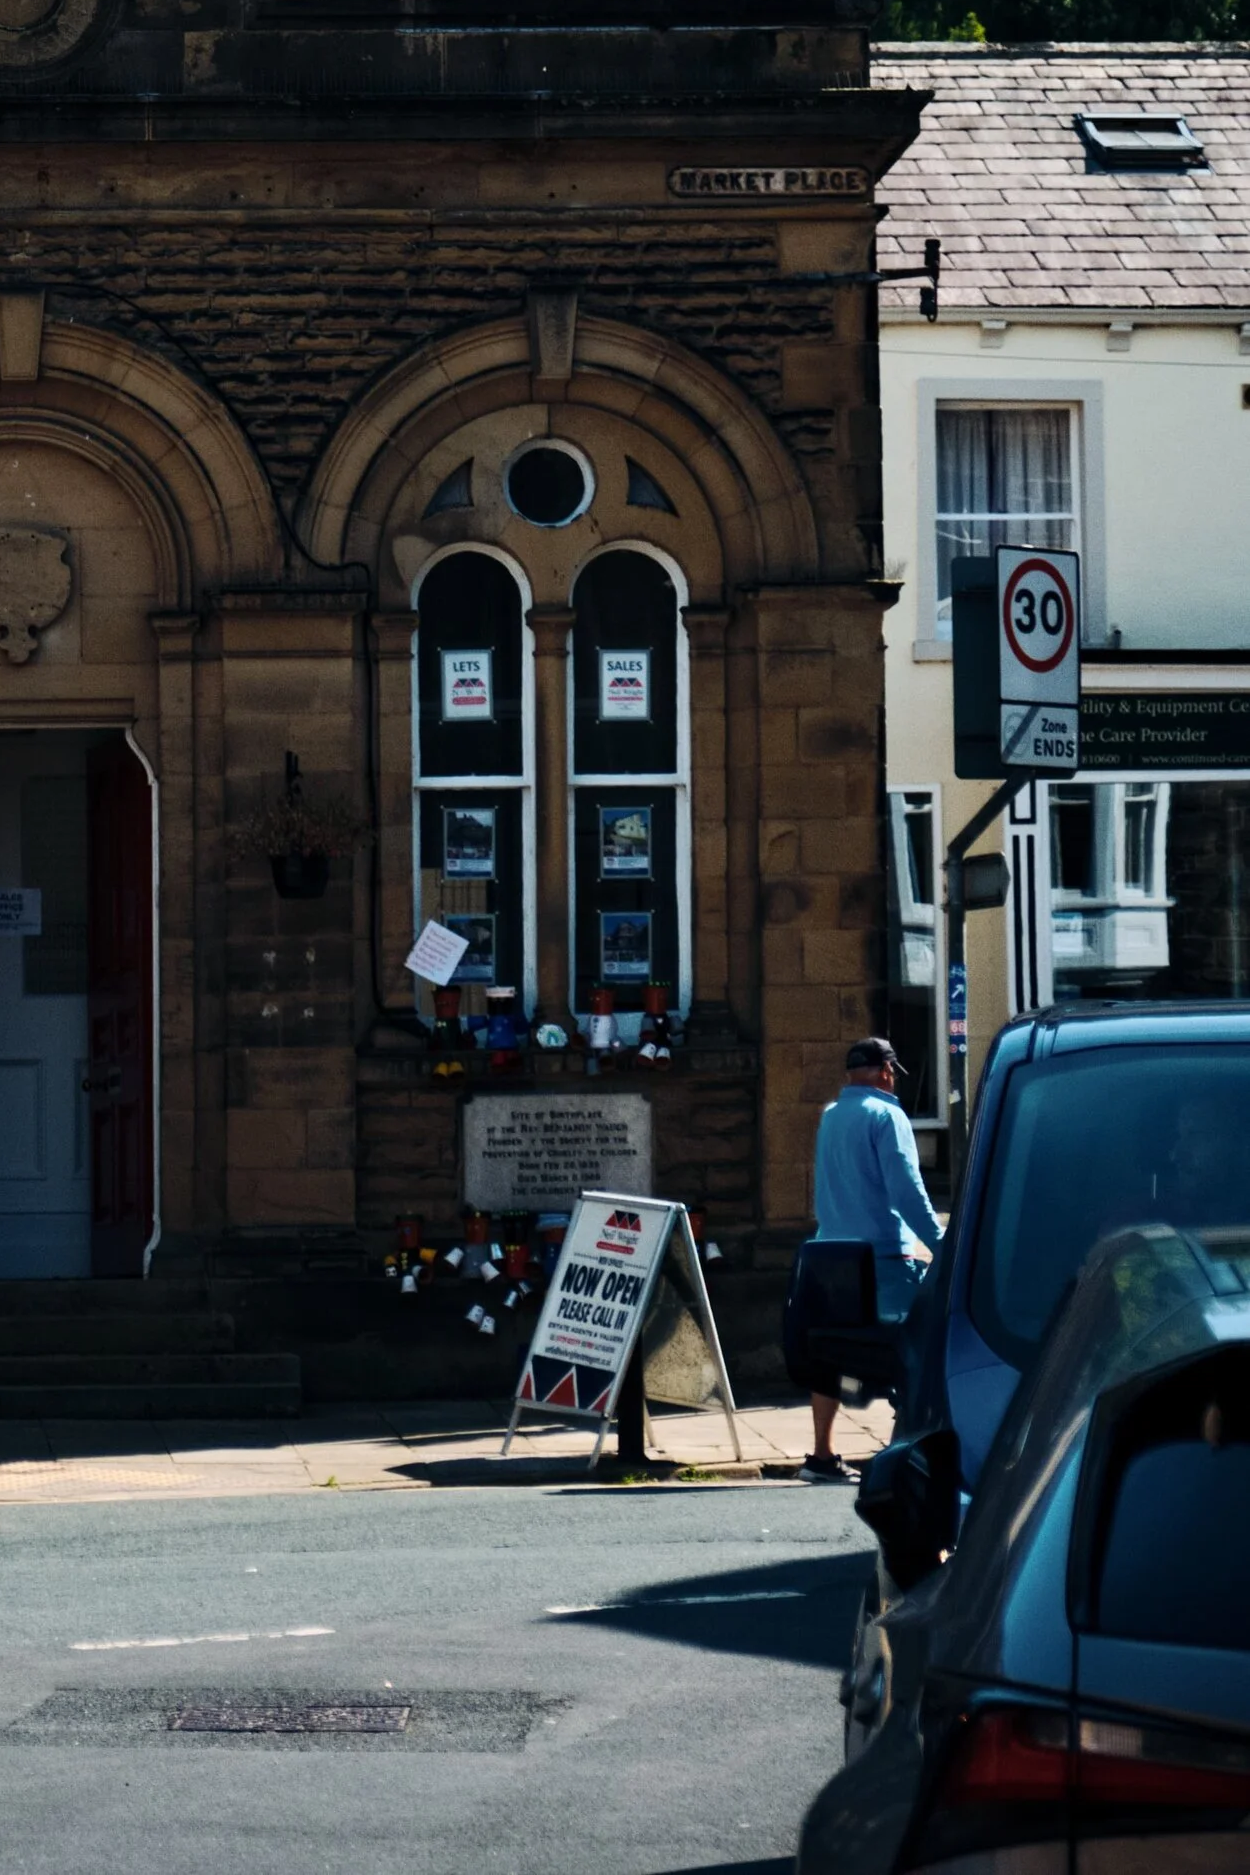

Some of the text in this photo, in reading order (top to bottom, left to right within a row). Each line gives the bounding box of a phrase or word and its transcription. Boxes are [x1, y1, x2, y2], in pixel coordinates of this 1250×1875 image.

[680, 171, 860, 191] MARKET PLACE
[1014, 588, 1063, 636] 30
[453, 661, 480, 672] LETS
[607, 660, 643, 671] SALES
[1119, 699, 1131, 713] &
[1136, 699, 1225, 717] Equipment
[1041, 718, 1067, 733] Zone
[1100, 727, 1136, 743] Care
[1140, 727, 1209, 742] Provider
[1034, 739, 1075, 758] ENDS
[560, 1263, 645, 1306] NOW OPEN
[557, 1298, 629, 1331] PLEASE CALL IN
